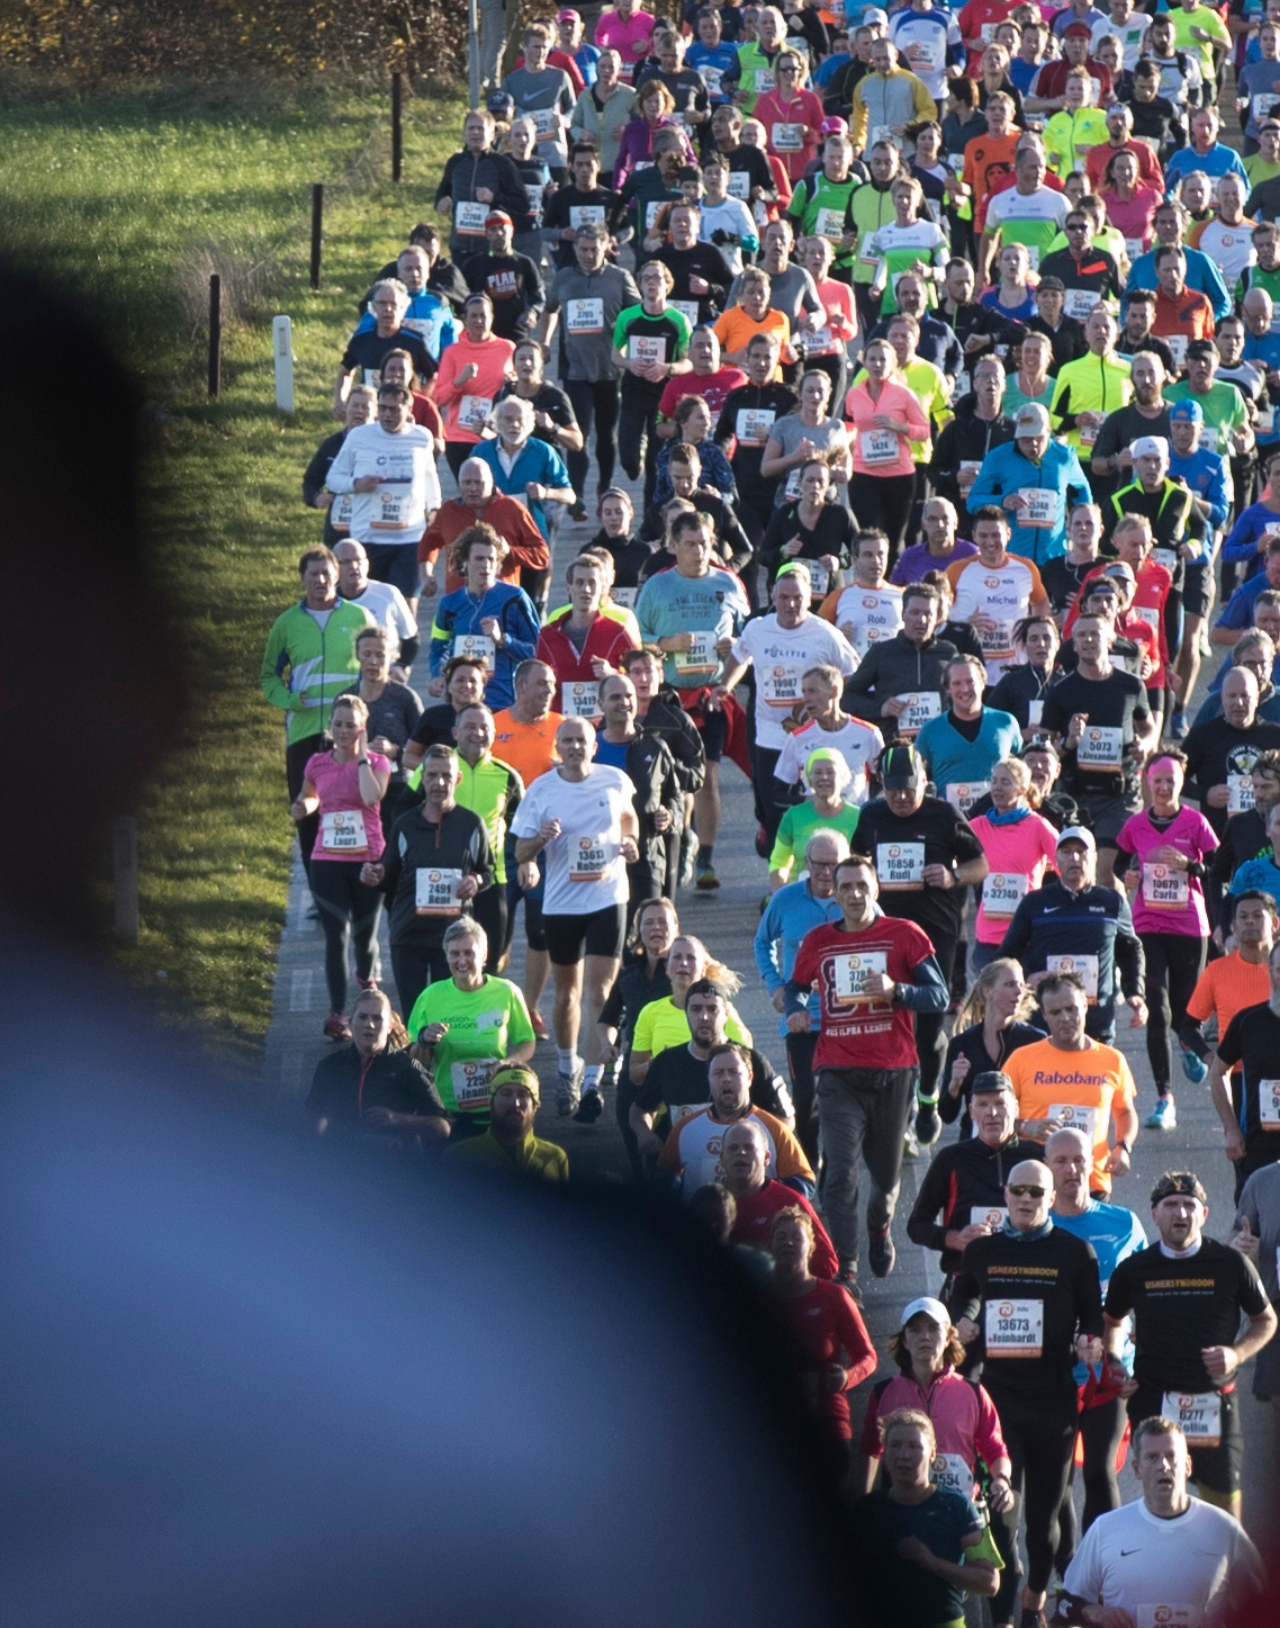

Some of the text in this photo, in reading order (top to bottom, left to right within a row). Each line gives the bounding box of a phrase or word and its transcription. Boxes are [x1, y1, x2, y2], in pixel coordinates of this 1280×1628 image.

[867, 614, 886, 624] Rob
[1033, 1070, 1109, 1087] Rabobank
[998, 1318, 1029, 1331] 13673
